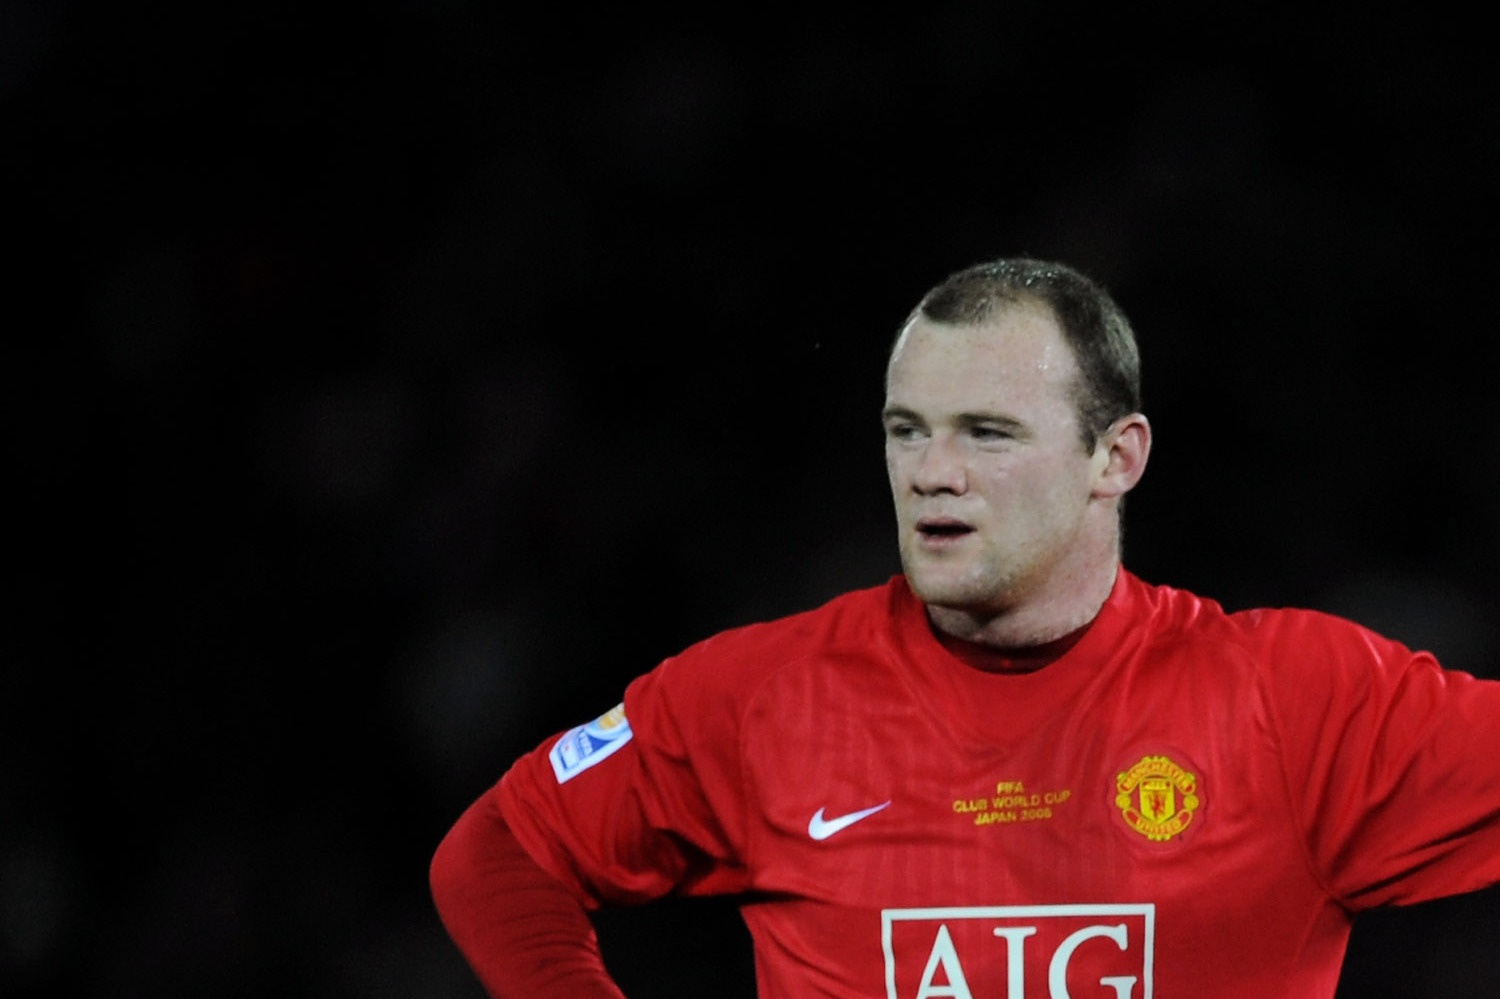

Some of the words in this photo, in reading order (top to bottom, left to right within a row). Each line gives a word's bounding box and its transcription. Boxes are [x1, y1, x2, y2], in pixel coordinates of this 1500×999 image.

[953, 799, 988, 813] CLUB
[992, 795, 1040, 808] WORLD
[1044, 790, 1071, 804] CUP
[975, 811, 1016, 825] JAPAN
